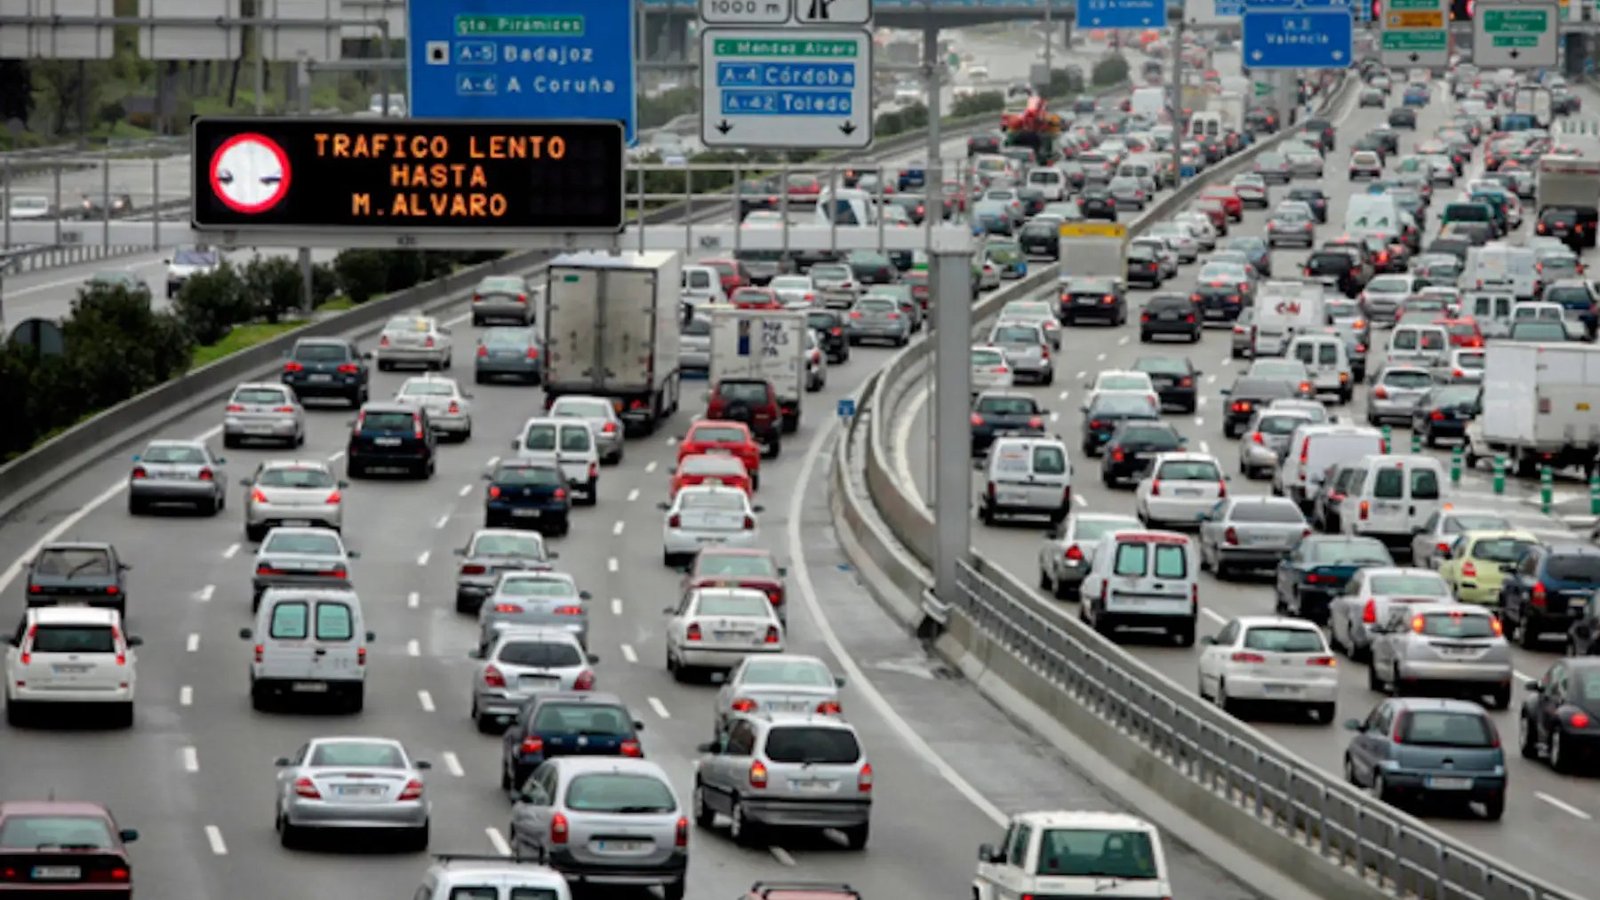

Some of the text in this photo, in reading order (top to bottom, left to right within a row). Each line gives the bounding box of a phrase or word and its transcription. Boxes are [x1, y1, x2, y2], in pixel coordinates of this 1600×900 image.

[766, 2, 780, 14] m
[1265, 32, 1329, 45] Valencia
[460, 45, 594, 66] A-5 Badajoz
[461, 75, 616, 94] A-6 A Coruña
[725, 67, 853, 84] A-4 Córdoba
[728, 93, 851, 112] A-42 Toledo
[314, 133, 567, 159] TRAFICO LENTO
[389, 164, 488, 188] HASTA
[351, 192, 508, 217] M.ALVARO
